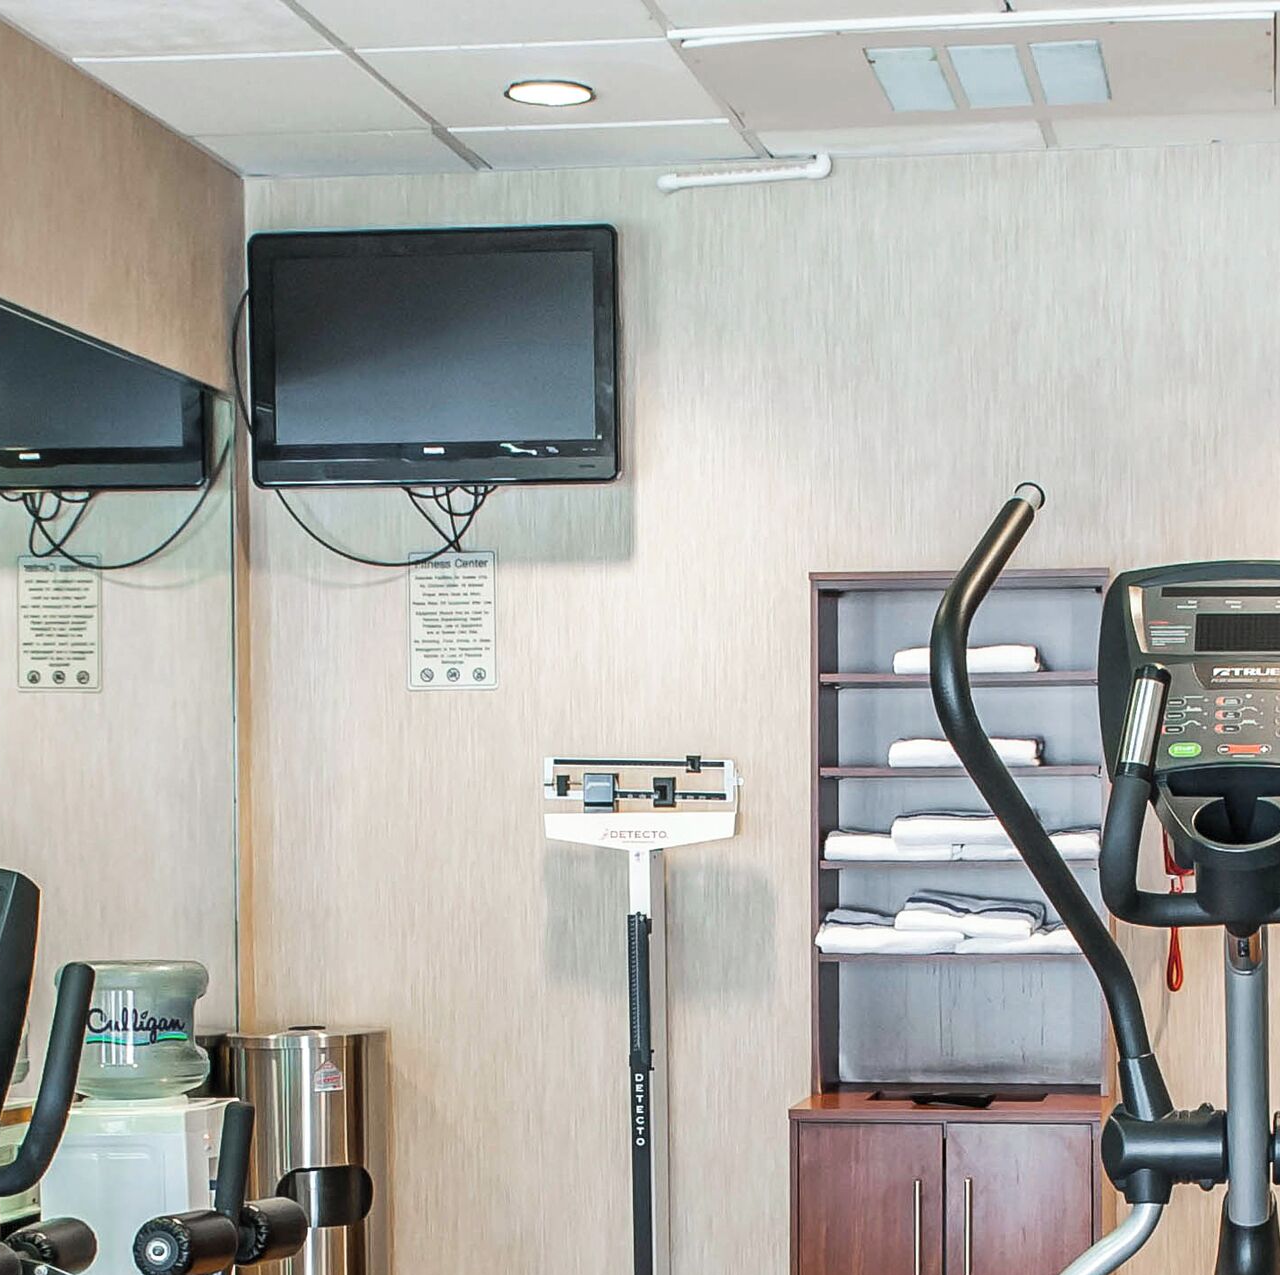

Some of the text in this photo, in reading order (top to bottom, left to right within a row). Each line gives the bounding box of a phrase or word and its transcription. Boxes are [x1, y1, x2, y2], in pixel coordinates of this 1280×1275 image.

[454, 558, 489, 569] Center
[1231, 667, 1280, 676] TRUE
[609, 830, 667, 839] DETECTO
[87, 1007, 186, 1044] Culligan
[634, 1073, 646, 1147] DETECTO
